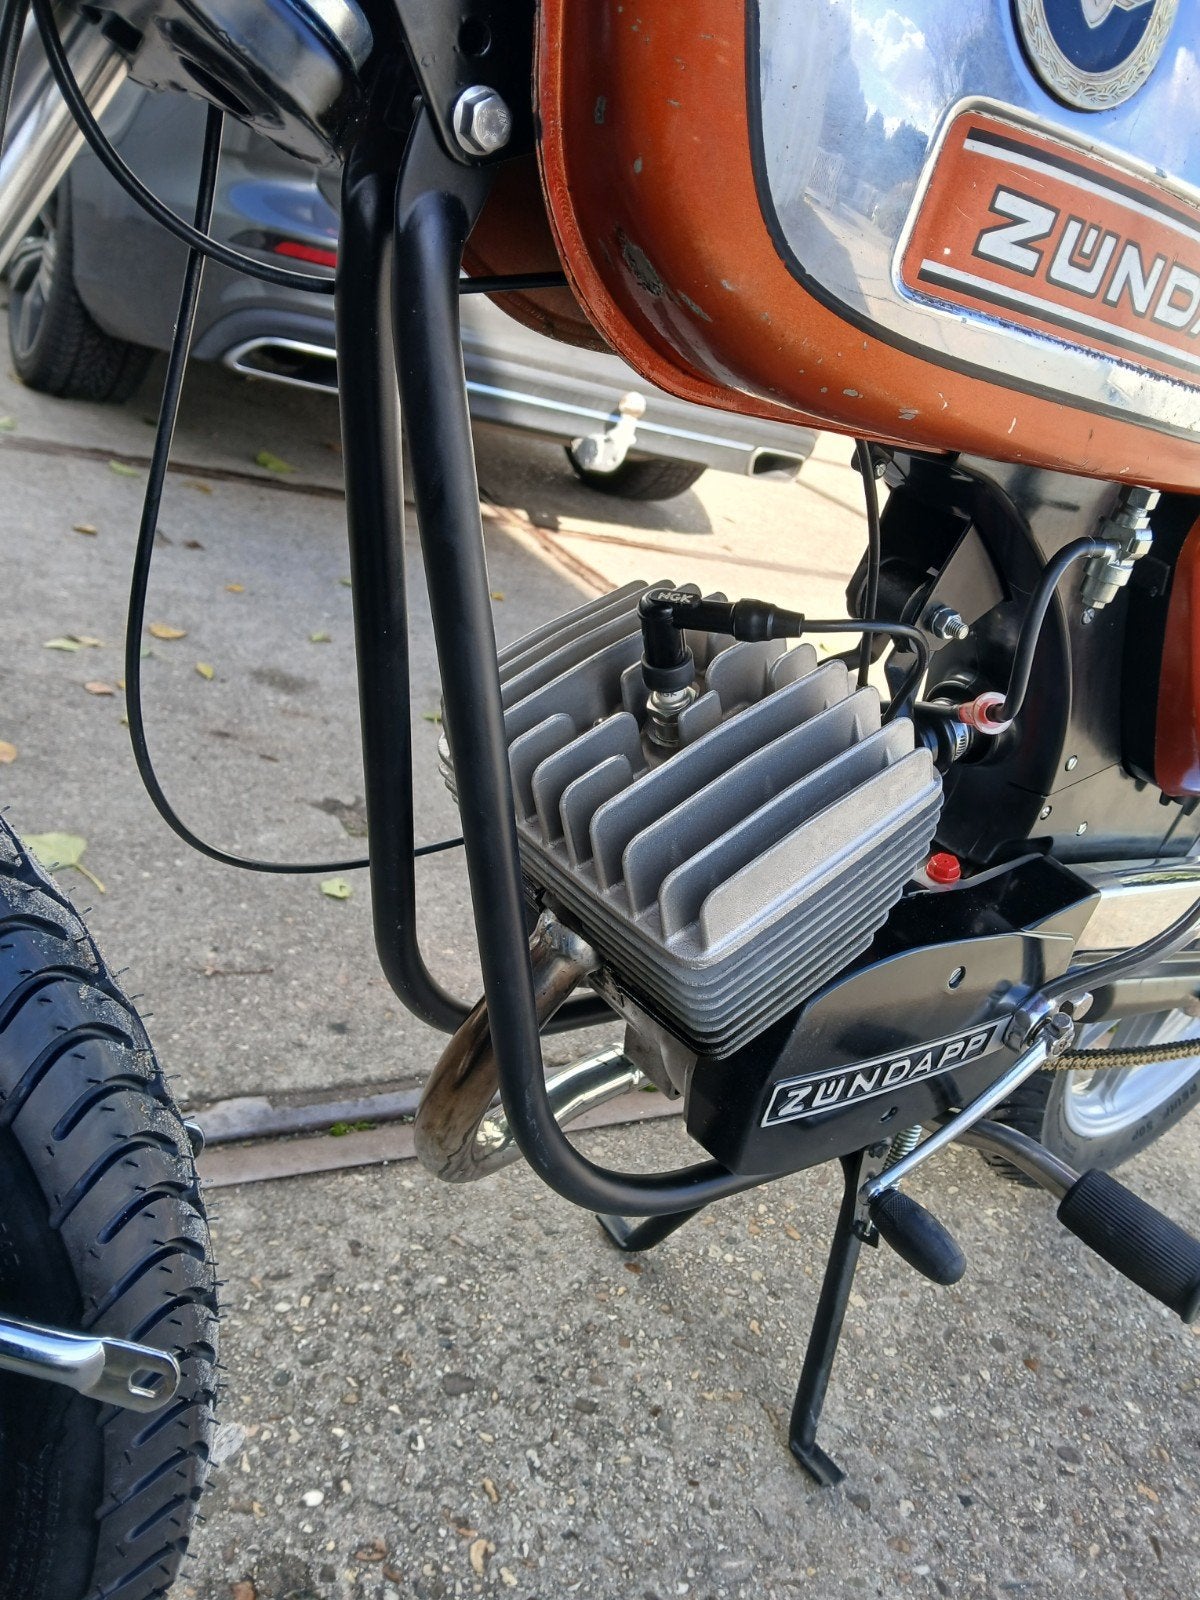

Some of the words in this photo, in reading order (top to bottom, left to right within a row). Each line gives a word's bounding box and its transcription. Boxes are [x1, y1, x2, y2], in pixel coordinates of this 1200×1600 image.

[972, 184, 1200, 339] ZÜND
[657, 592, 693, 603] NGK
[778, 1032, 988, 1117] ZÜNDAPP
